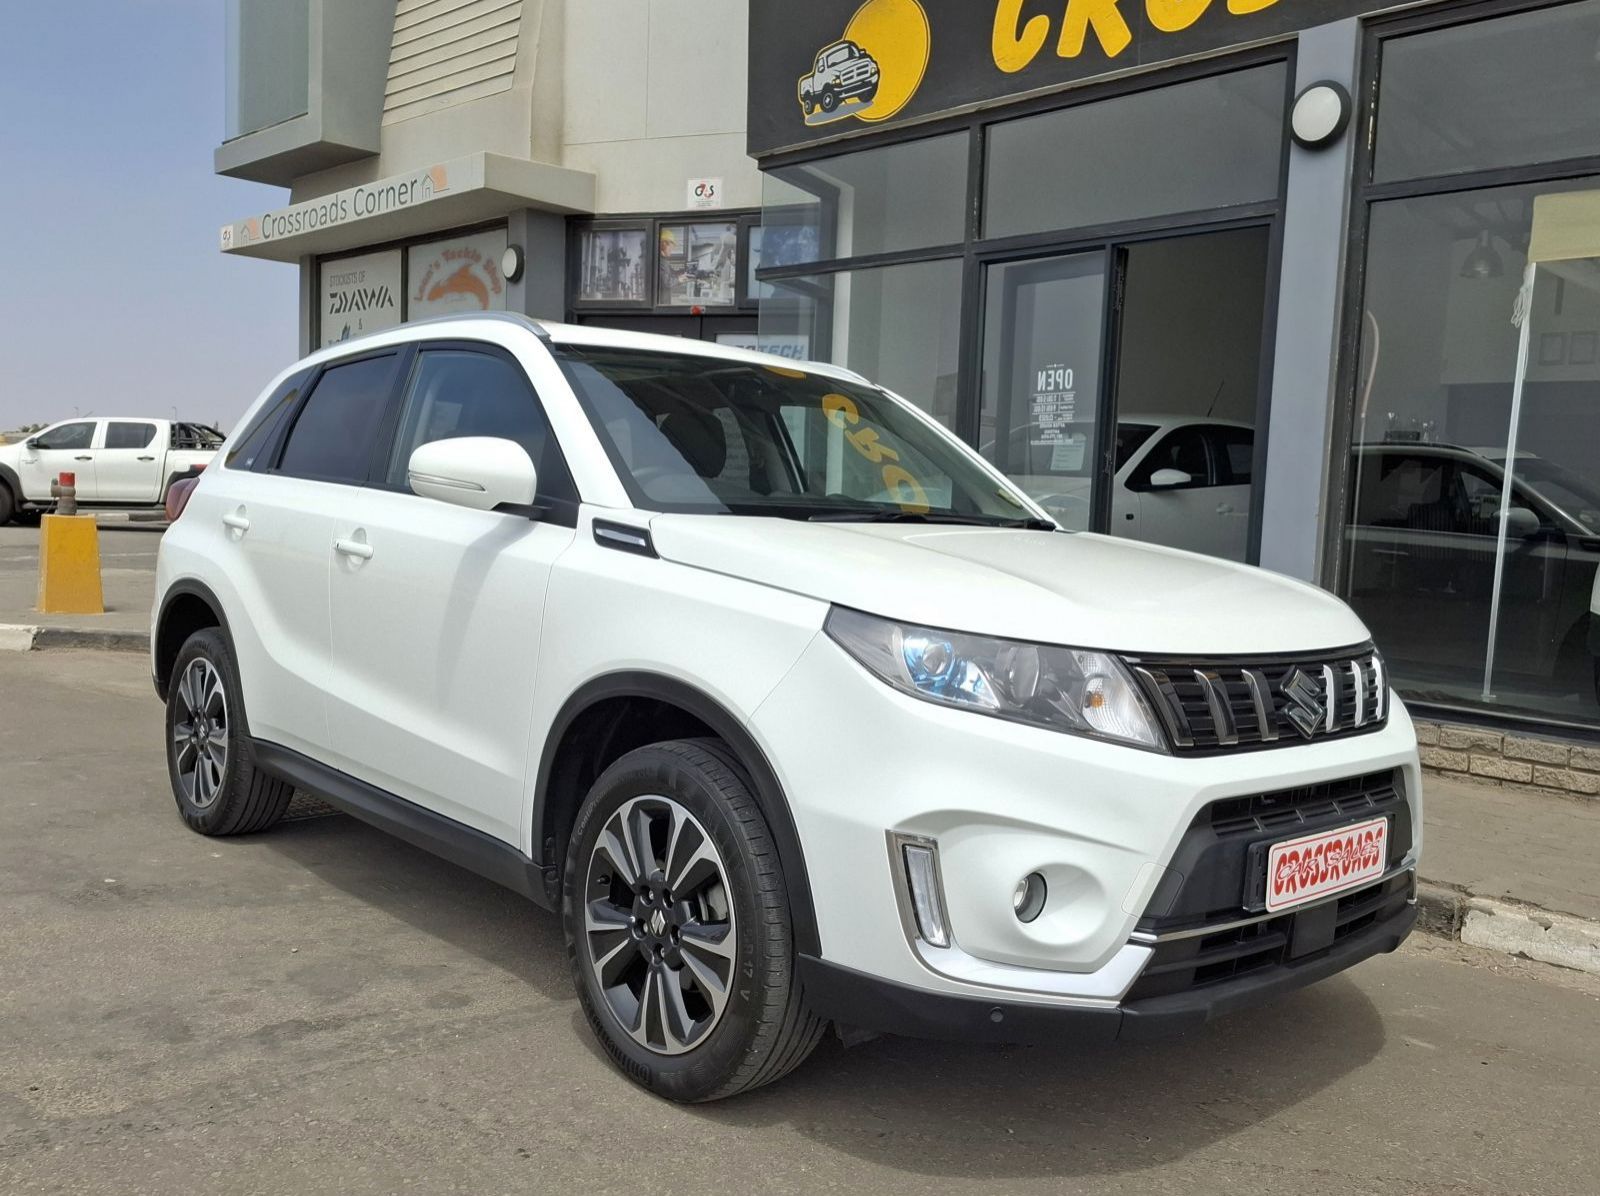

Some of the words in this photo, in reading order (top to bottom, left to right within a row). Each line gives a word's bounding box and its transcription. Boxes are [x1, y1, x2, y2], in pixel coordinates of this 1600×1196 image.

[261, 194, 347, 240] Crossroads
[353, 178, 418, 217] Corner
[329, 285, 394, 314] DAIWA
[1274, 826, 1384, 896] CROSSROADS
